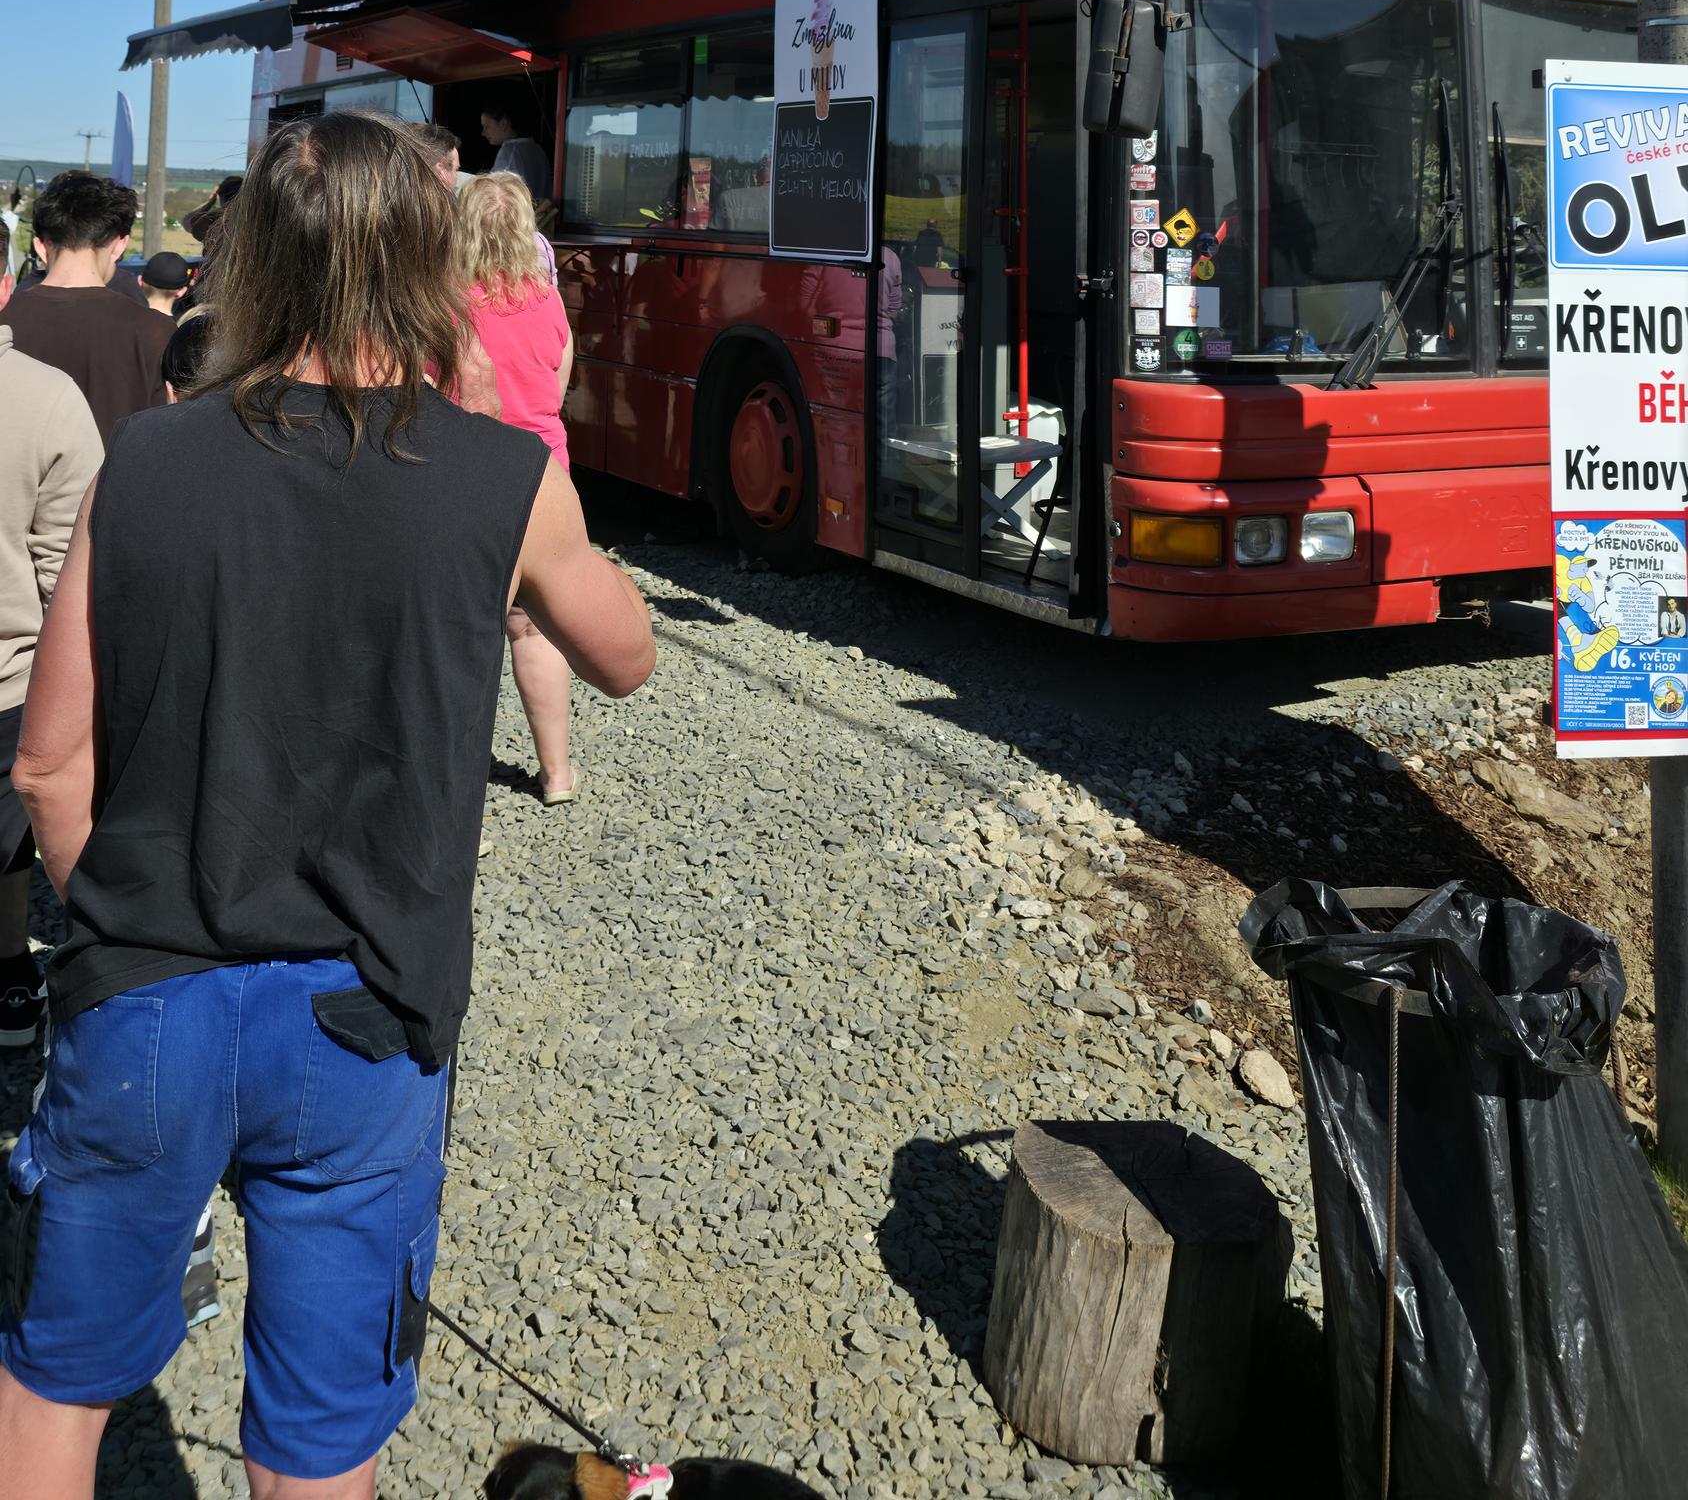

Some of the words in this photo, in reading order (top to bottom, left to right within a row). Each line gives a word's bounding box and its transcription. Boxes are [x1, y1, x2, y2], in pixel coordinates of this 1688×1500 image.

[791, 7, 857, 54] Zmrzlina
[799, 67, 806, 93] U
[810, 63, 847, 92] MILDY
[1626, 143, 1671, 164] české
[1567, 164, 1688, 255] OL
[1556, 288, 1688, 355] KŘENO
[1184, 331, 1193, 345] 4
[1207, 343, 1231, 352] DICHT
[1595, 534, 1679, 553] KŘENOVSKOU
[1611, 648, 1636, 669] 16.
[1639, 648, 1681, 662] KVĚTEN
[1643, 663, 1652, 671] 12
[1654, 663, 1676, 671] HOD
